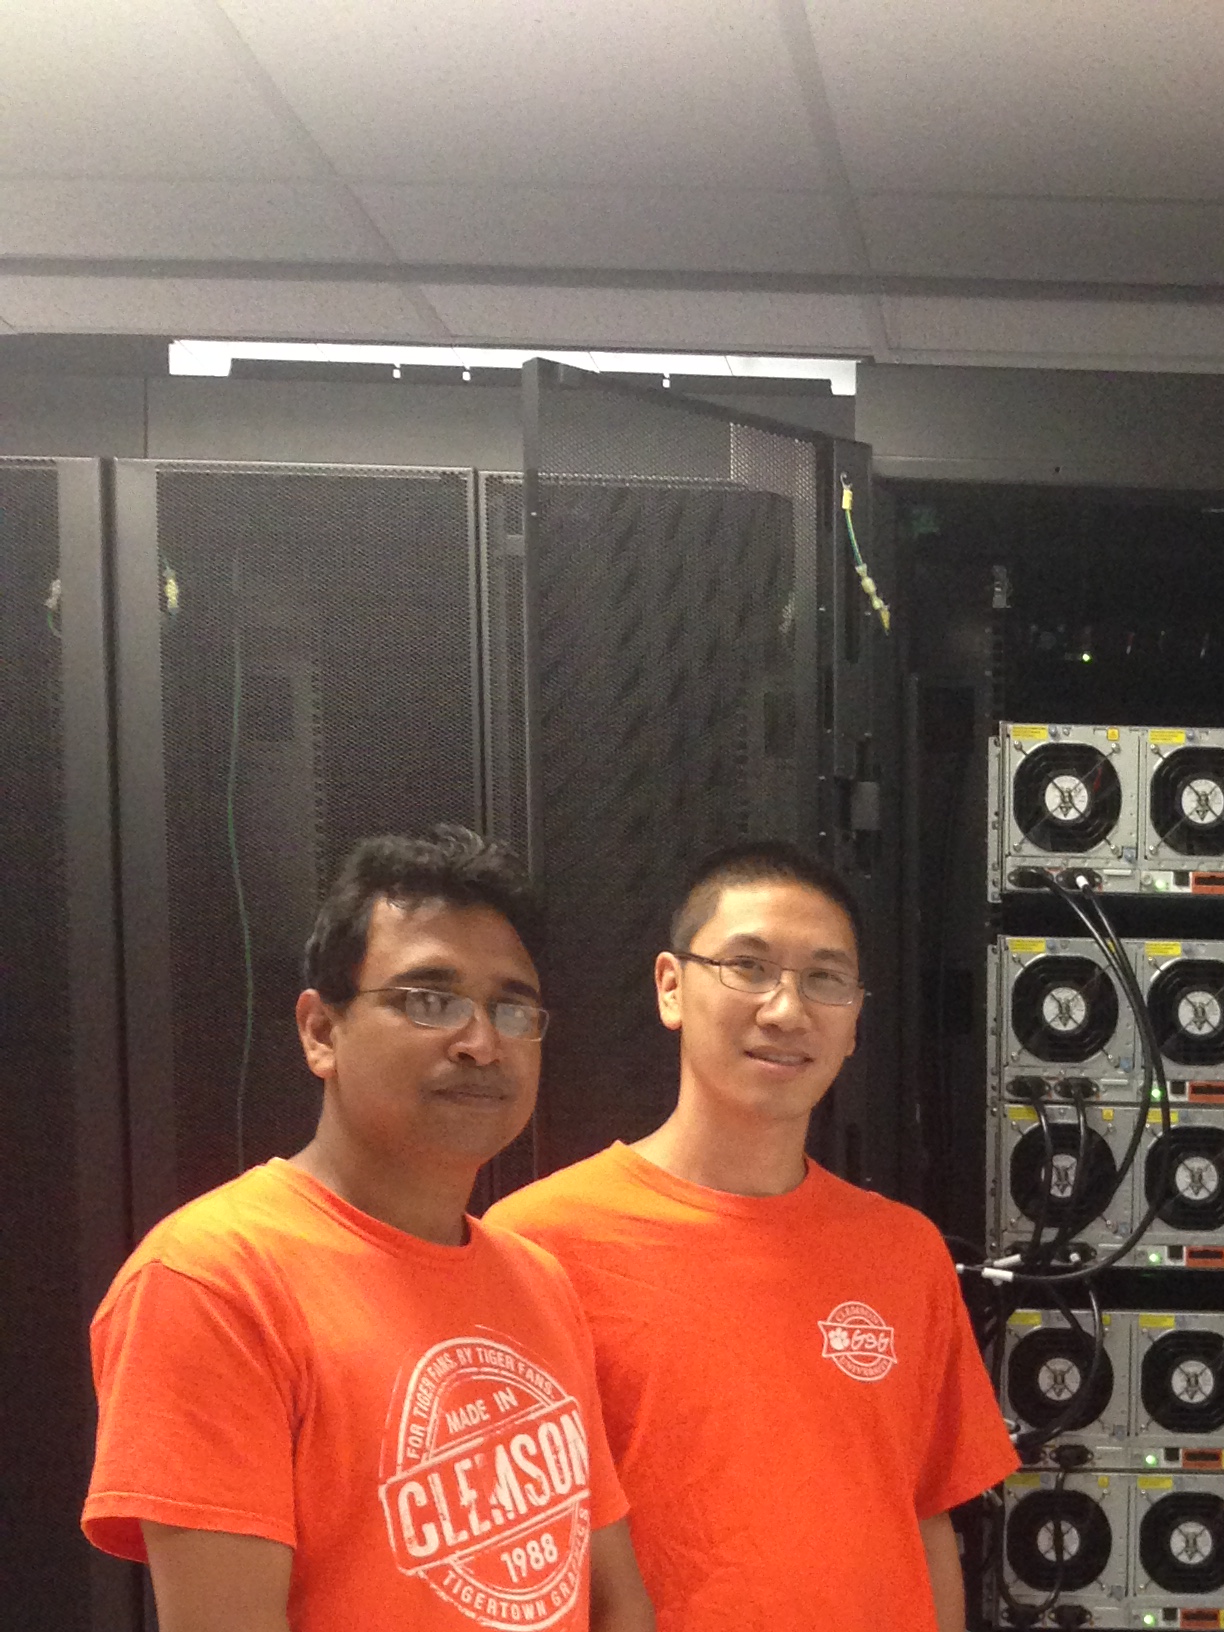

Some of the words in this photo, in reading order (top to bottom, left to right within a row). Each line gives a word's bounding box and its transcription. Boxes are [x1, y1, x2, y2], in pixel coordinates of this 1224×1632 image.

[455, 1347, 474, 1364] BY
[476, 1347, 515, 1371] TIGER
[413, 1376, 437, 1419] TIGER
[517, 1362, 553, 1396] FANS
[445, 1399, 490, 1434] MADE
[492, 1386, 519, 1413] IN
[406, 1423, 426, 1460] FOR
[397, 1409, 588, 1558] CLEMSON
[500, 1532, 558, 1584] 1988
[443, 1569, 548, 1621] TIGERTOWN
